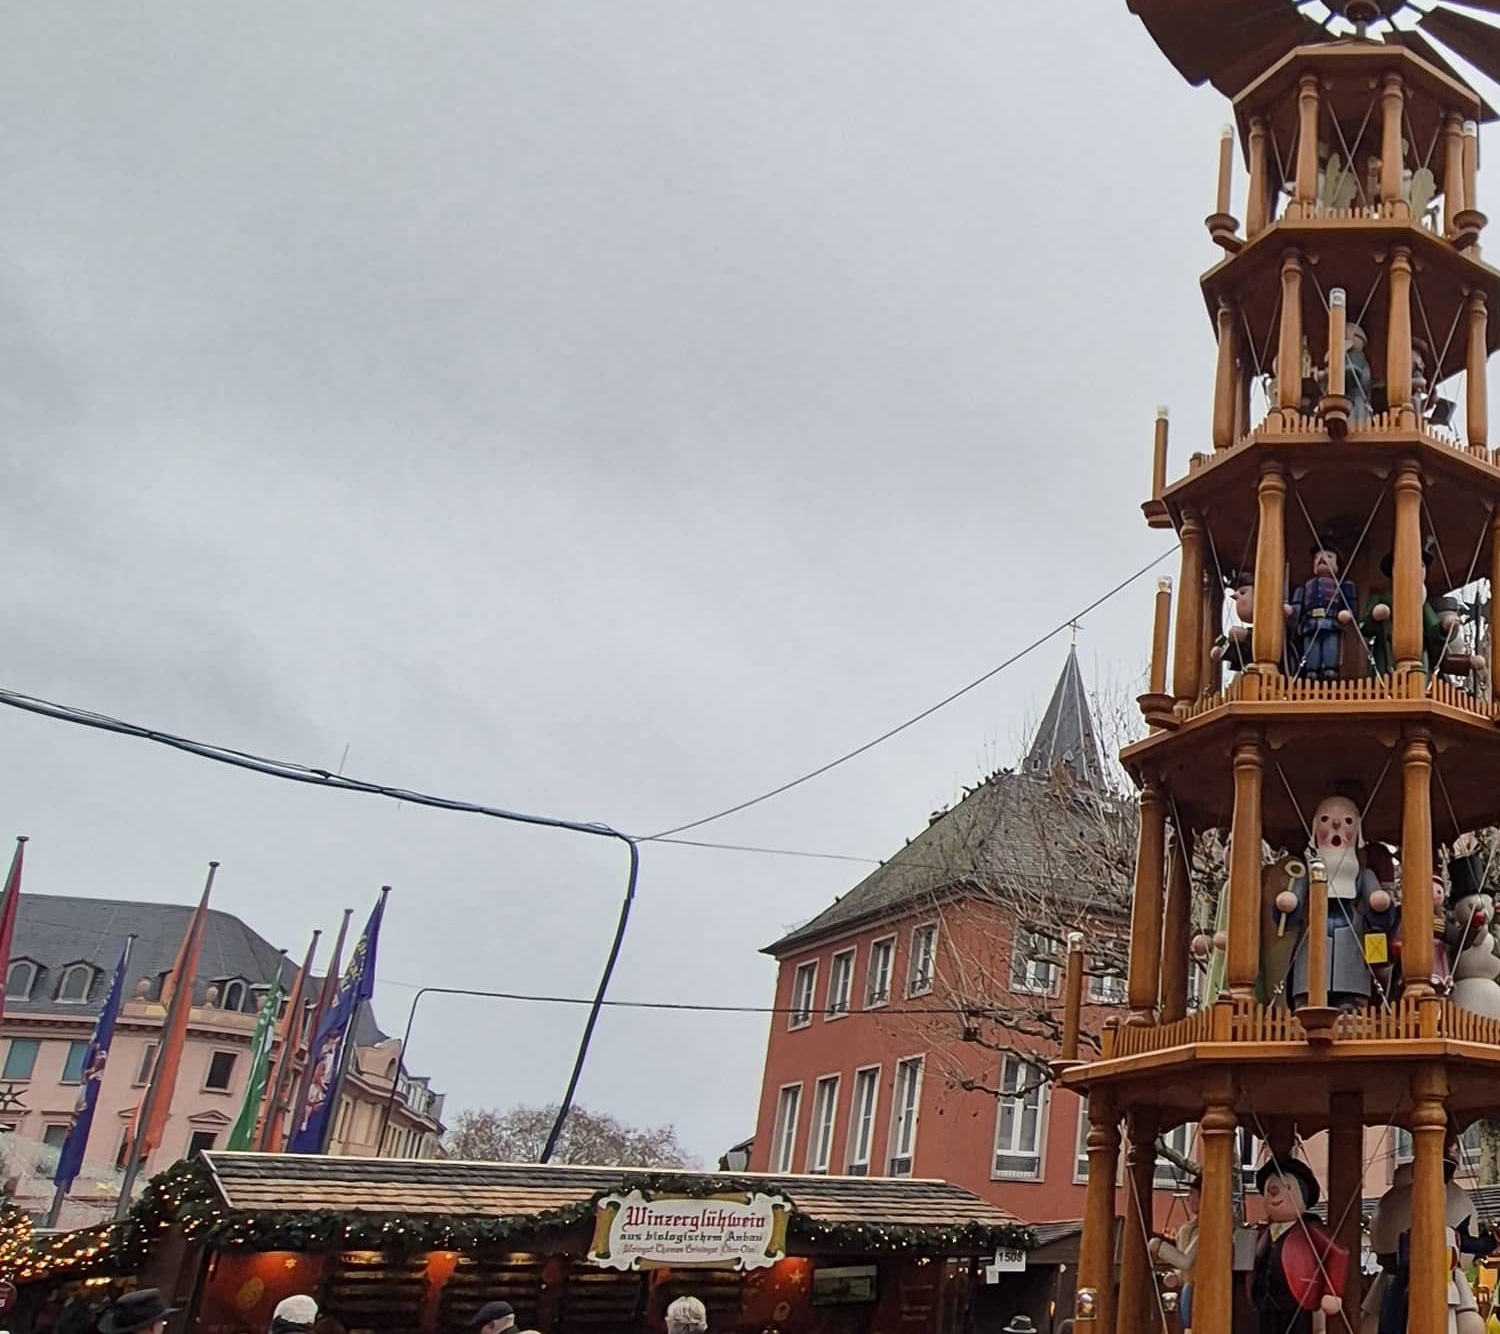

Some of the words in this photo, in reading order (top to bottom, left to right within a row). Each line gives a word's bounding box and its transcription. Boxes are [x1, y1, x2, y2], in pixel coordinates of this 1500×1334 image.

[621, 1206, 766, 1234] Winzerglühwein
[620, 1233, 643, 1241] aus
[645, 1231, 723, 1244] biologischem
